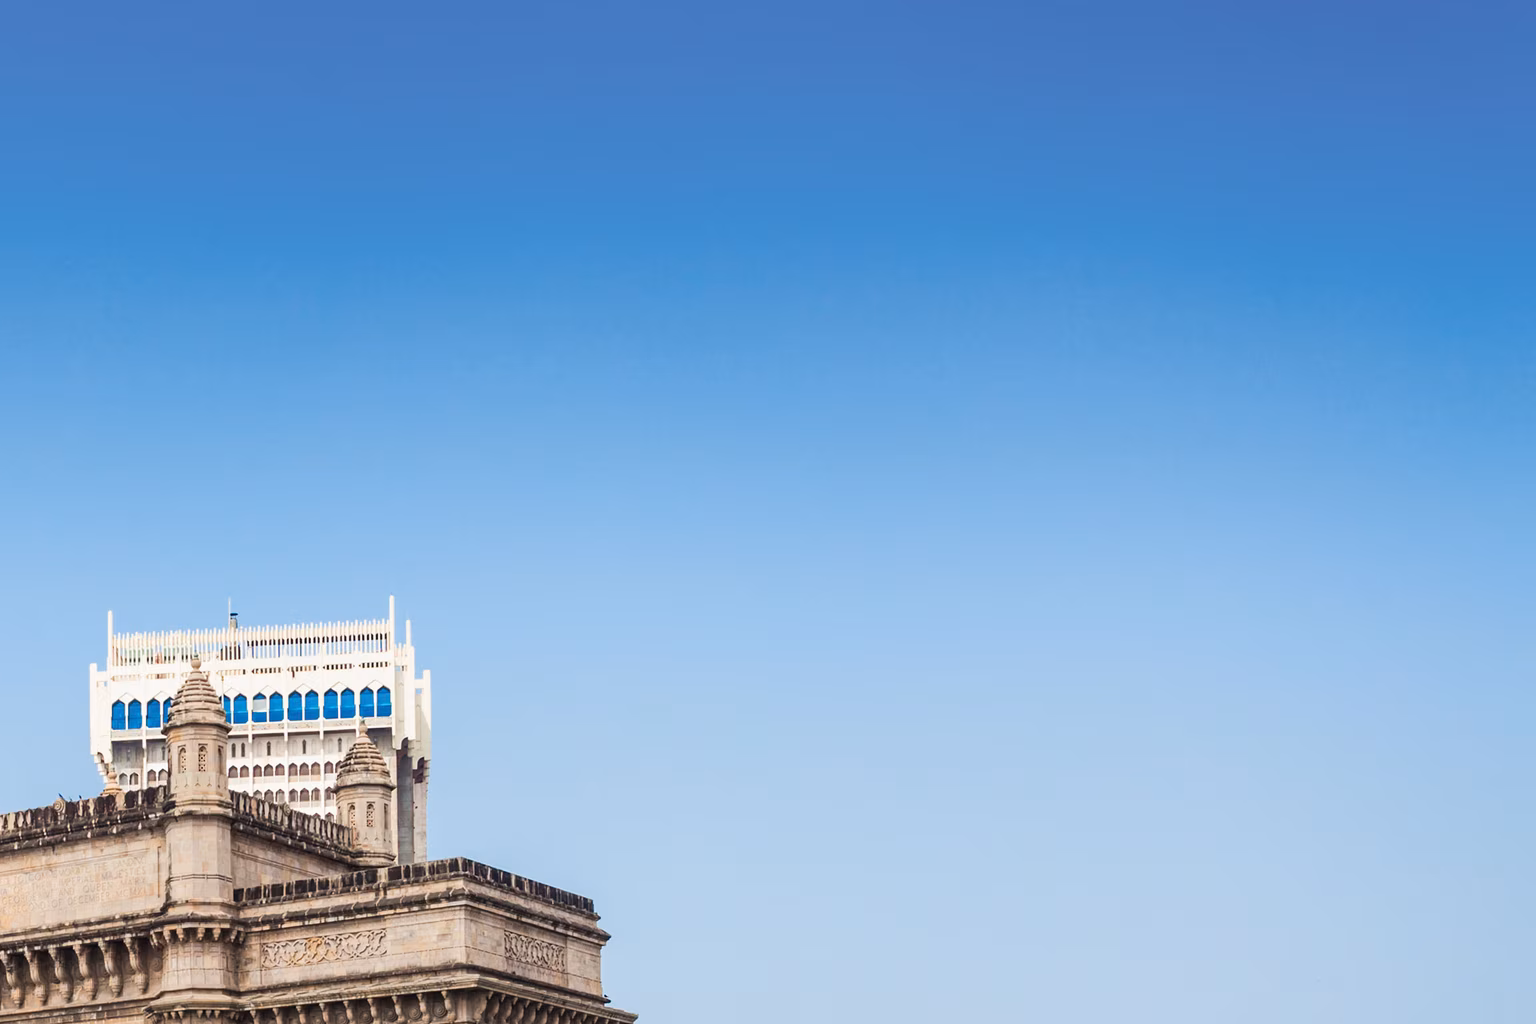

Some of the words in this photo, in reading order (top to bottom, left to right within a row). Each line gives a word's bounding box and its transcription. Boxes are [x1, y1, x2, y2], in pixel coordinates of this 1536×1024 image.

[101, 866, 147, 881] MAJESTIES
[59, 887, 75, 898] AND
[82, 881, 113, 894] QUEEN
[51, 898, 62, 909] OF
[67, 891, 110, 906] DECEMBER
